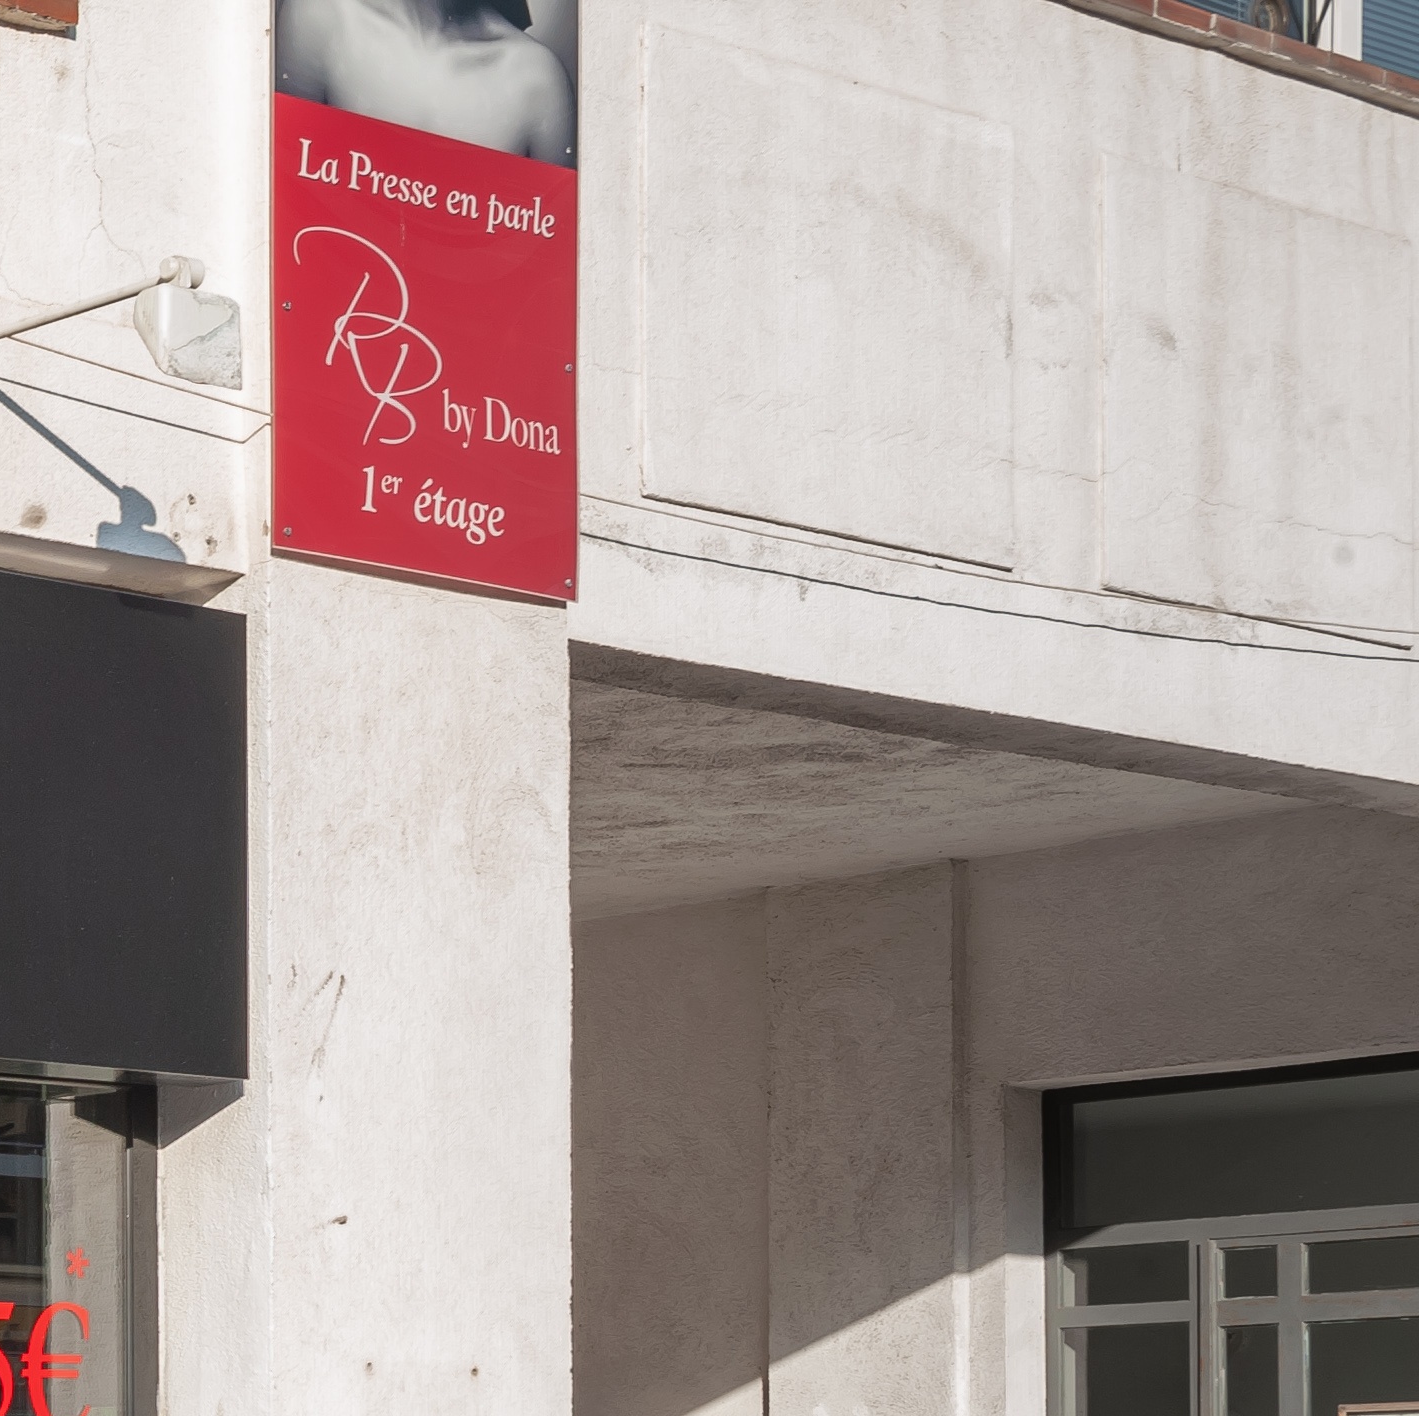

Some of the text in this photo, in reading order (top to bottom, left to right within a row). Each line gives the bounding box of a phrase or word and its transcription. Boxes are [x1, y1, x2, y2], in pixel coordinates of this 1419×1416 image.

[297, 138, 556, 240] La Presse en parle
[442, 388, 562, 457] by Dona
[414, 477, 506, 546] étage
